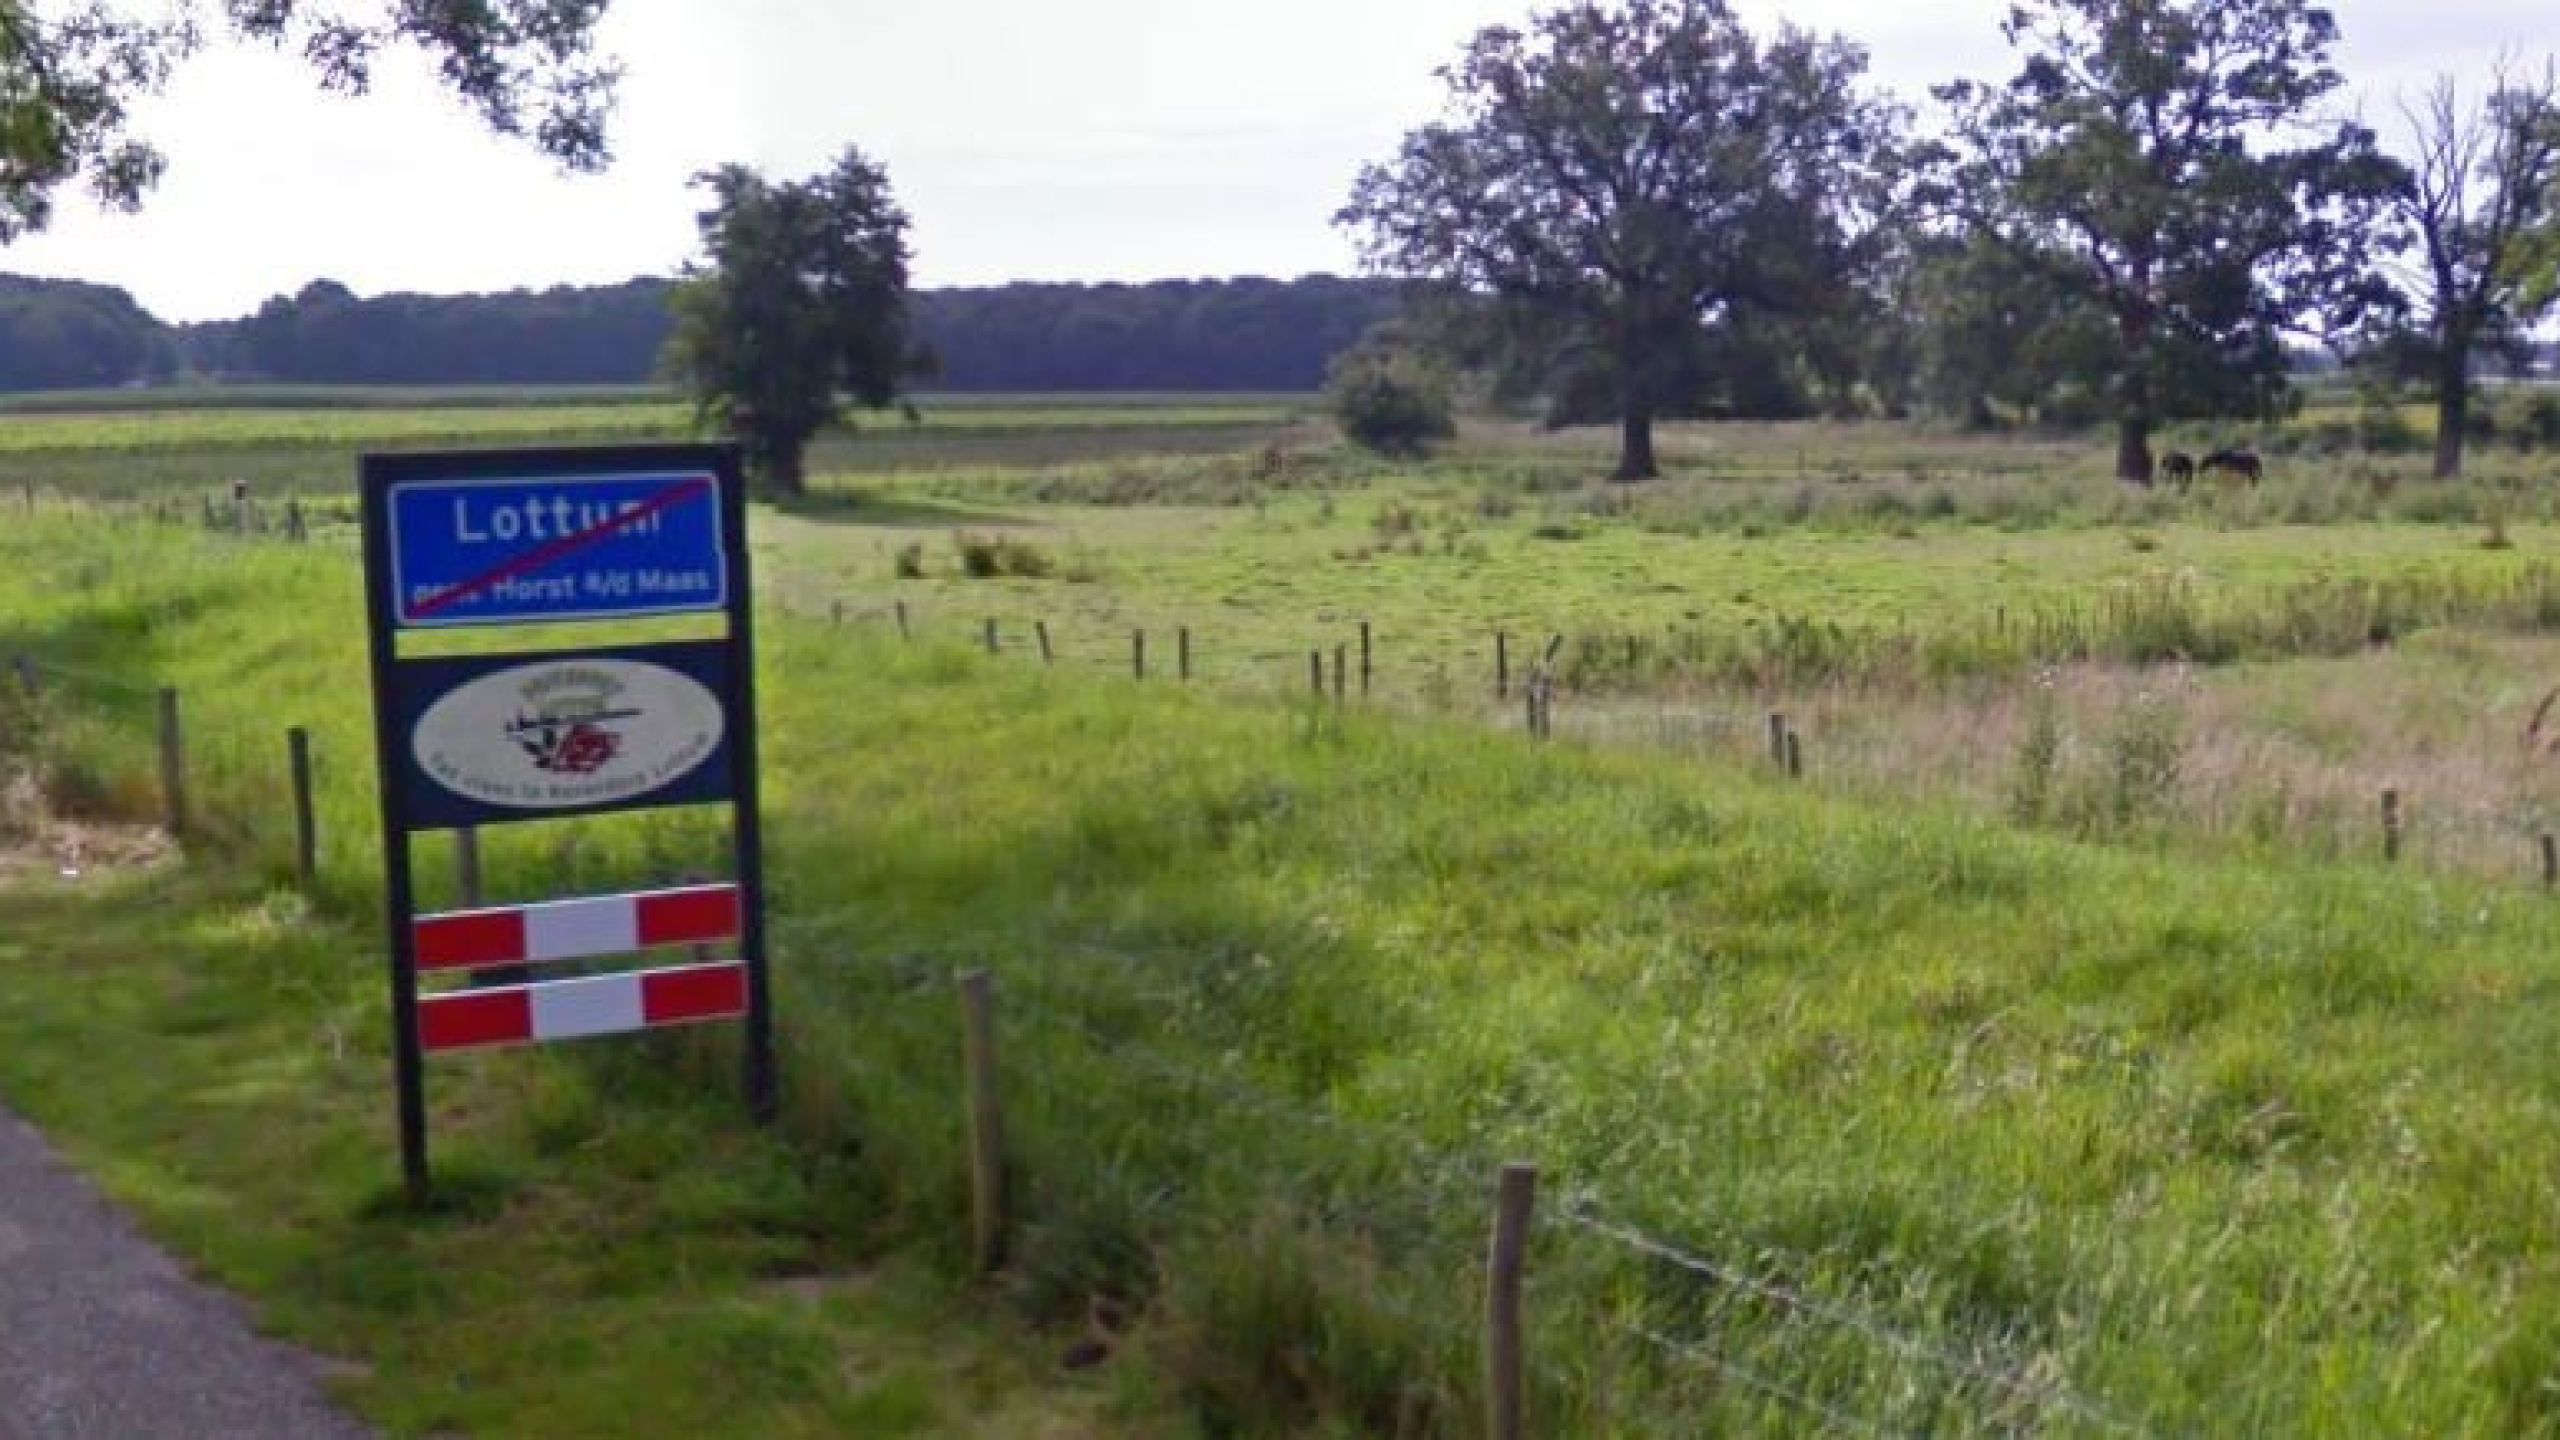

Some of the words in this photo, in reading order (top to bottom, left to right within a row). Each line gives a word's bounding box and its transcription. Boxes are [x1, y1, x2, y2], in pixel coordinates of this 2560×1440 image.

[454, 493, 661, 543] Lottum
[491, 571, 576, 603] Horst
[637, 566, 711, 593] Maas
